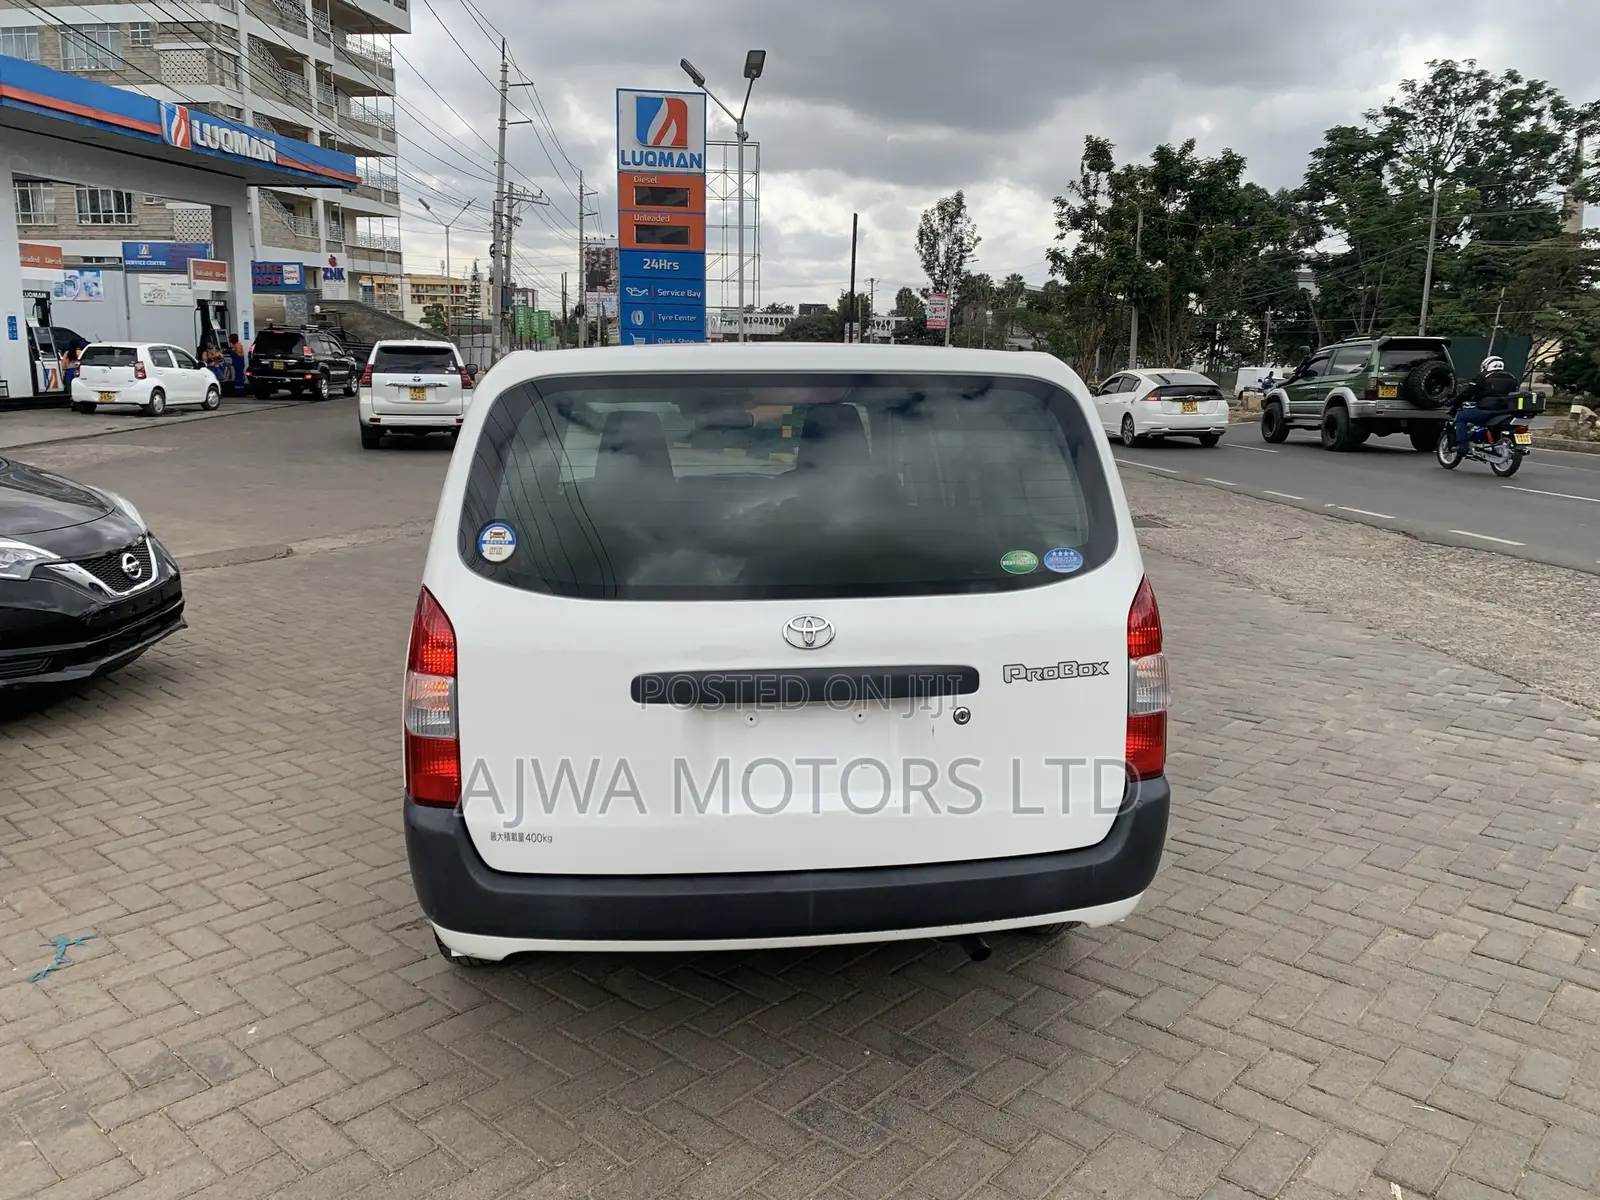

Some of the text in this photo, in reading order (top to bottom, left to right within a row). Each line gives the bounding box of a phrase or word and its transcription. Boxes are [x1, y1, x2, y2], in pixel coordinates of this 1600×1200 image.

[192, 119, 276, 163] LUQMAN
[621, 150, 703, 169] LUQMAN
[633, 175, 658, 184] Diesel
[633, 214, 670, 222] Unleaded
[643, 258, 680, 270] 24Hrs
[322, 267, 347, 280] ZNK
[657, 289, 701, 299] Service Bay
[658, 313, 673, 322] Tyre
